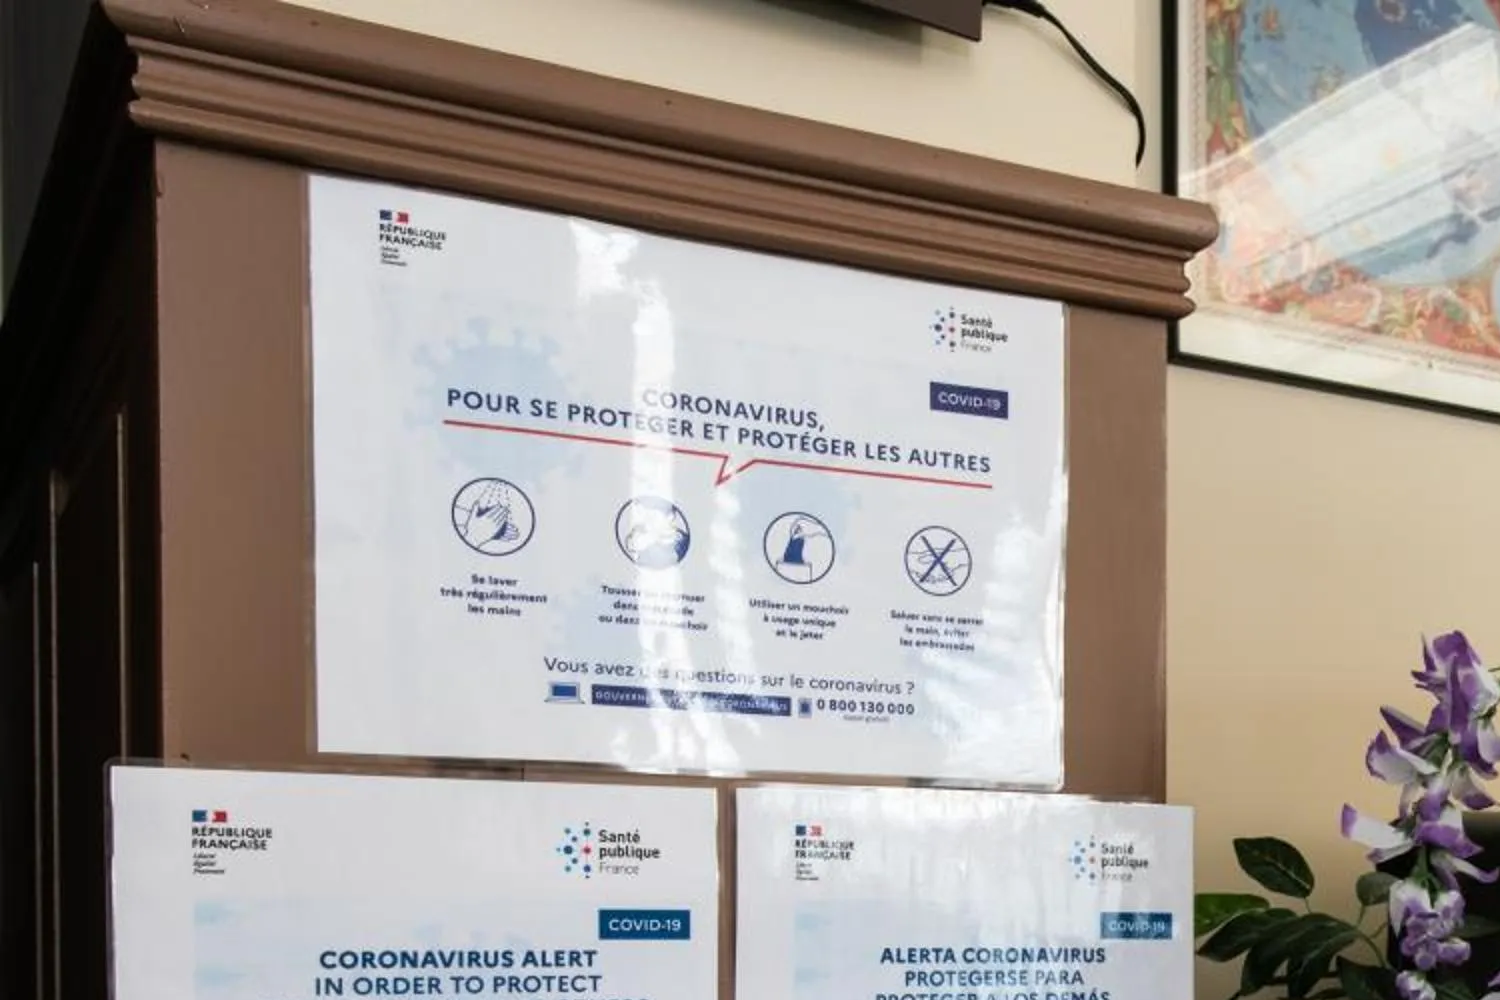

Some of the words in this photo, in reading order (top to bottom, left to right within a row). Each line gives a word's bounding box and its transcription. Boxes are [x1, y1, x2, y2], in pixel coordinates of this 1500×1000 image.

[960, 327, 1008, 343] publique
[938, 391, 1001, 411] COVID-19
[642, 388, 825, 432] CORONAVIRUS,
[447, 387, 521, 416] POUR
[530, 399, 559, 420] SE
[702, 422, 730, 443] ET
[737, 428, 857, 459] PROTÉGER
[865, 442, 901, 464] LES
[908, 447, 992, 474] AUTRES
[471, 573, 485, 586] Se
[488, 574, 518, 588] laver
[440, 586, 464, 599] très
[466, 587, 548, 605] régulièrement
[467, 602, 485, 614] les
[487, 604, 522, 617] mains
[543, 656, 589, 675] Vous
[594, 661, 636, 678] avez
[760, 673, 784, 688] sur
[790, 673, 805, 689] le
[809, 676, 902, 696] coronavirus
[829, 698, 858, 713] 800
[860, 700, 885, 714] 130
[887, 702, 916, 716] 000
[192, 825, 273, 839] RÉPUBLIQUE
[598, 828, 641, 844] Santé
[192, 838, 268, 851] FRANÇAISE
[1101, 842, 1135, 855] Santé
[599, 845, 661, 862] publique
[599, 861, 640, 876] France
[1101, 855, 1149, 870] publique
[608, 918, 682, 932] COVID-19
[319, 950, 515, 970] CORONAVIRUS
[521, 949, 598, 968] ALERT
[880, 947, 957, 965] ALERTA
[962, 947, 1107, 965] CORONAVIRUS
[315, 977, 344, 996] IN
[353, 976, 443, 996] ORDER
[450, 975, 485, 995] TO
[492, 974, 603, 994] PROTECT
[904, 970, 1029, 988] PROTEGERSE
[1035, 969, 1085, 986] PARA
